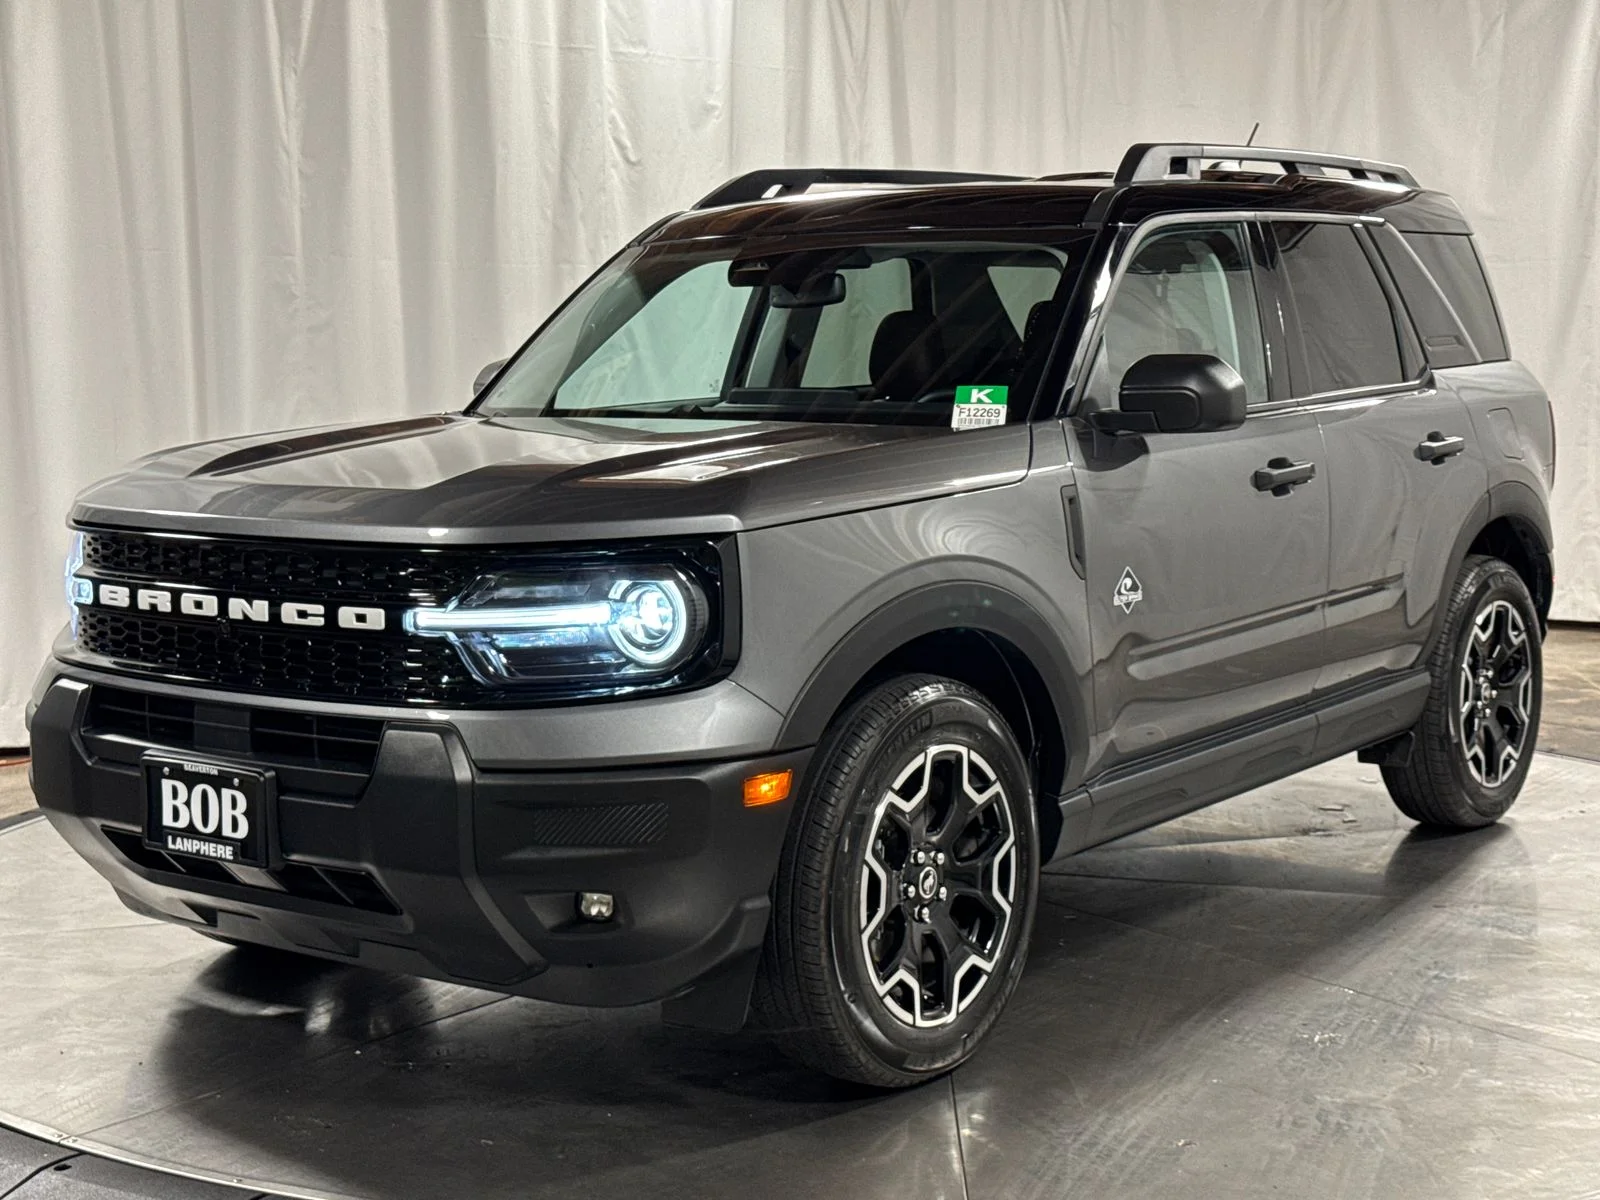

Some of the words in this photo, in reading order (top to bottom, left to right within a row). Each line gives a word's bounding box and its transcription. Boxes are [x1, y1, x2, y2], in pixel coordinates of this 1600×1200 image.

[970, 388, 994, 403] K
[958, 407, 1001, 418] F12269
[99, 584, 385, 630] BRONCO
[183, 764, 218, 776] BEAVERTON
[161, 778, 249, 839] BOB
[167, 835, 234, 860] LANPHERE
